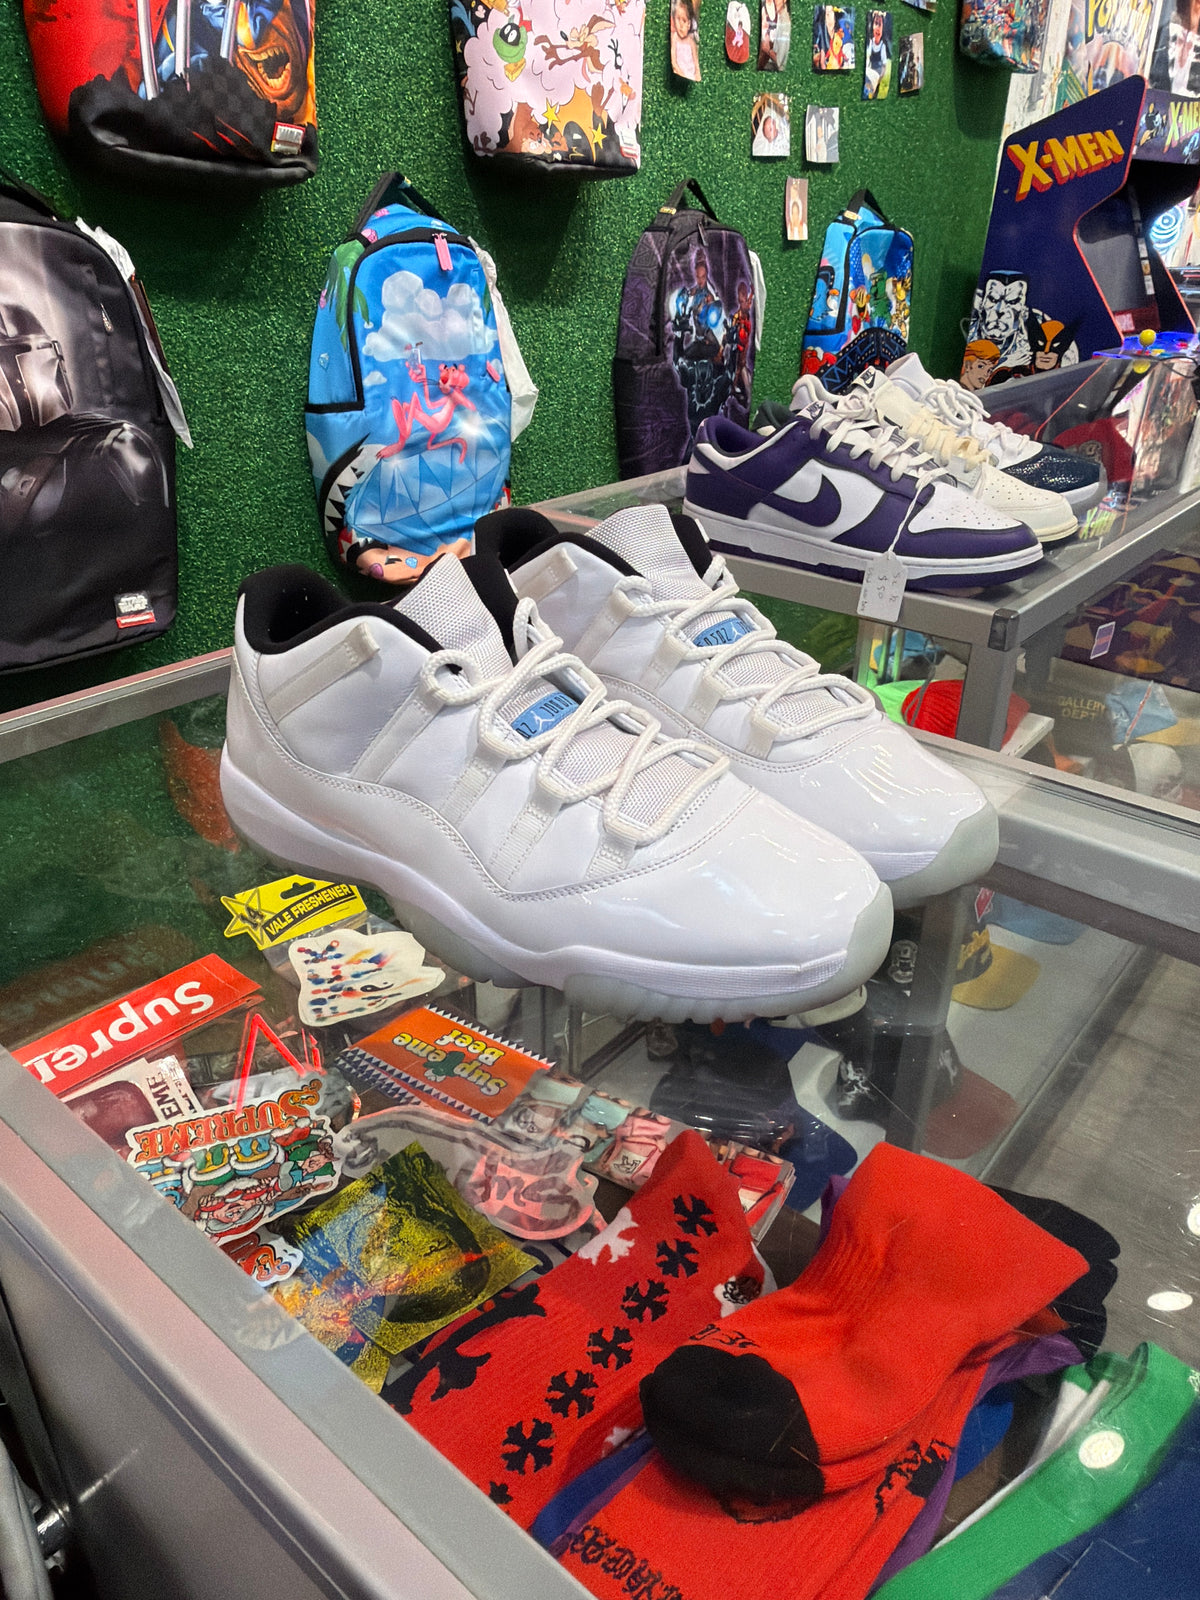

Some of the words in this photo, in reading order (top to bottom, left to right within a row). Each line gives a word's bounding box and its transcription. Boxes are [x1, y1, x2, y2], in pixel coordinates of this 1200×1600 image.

[1007, 129, 1125, 202] X-MEN
[265, 911, 294, 936] VALE
[293, 883, 352, 919] FRESHENER
[435, 1029, 505, 1066] Beef
[134, 1079, 323, 1164] SUPREME
